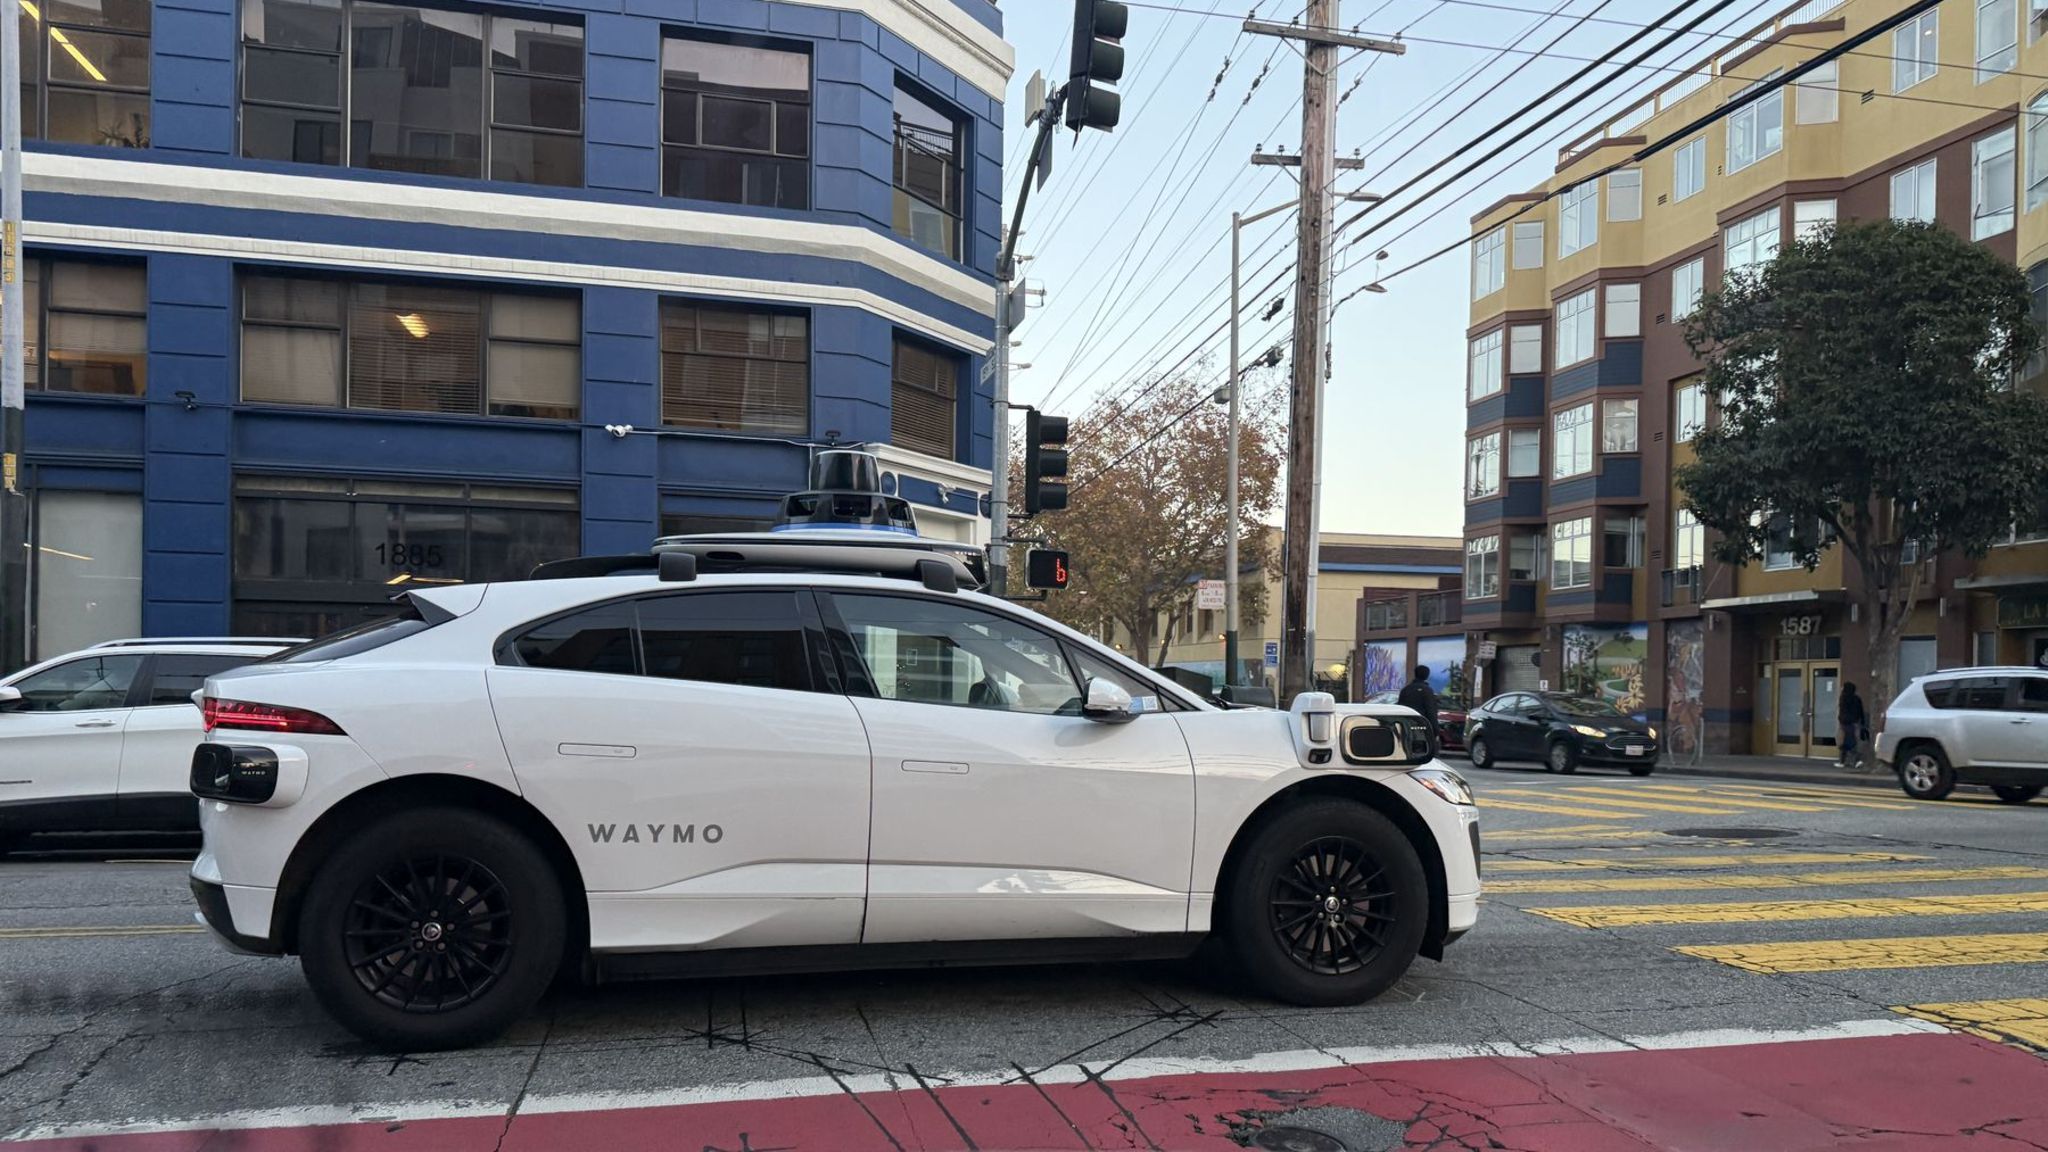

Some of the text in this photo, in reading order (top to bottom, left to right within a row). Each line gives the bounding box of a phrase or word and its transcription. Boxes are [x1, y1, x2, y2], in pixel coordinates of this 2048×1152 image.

[375, 542, 443, 567] 1885
[1780, 616, 1822, 635] 1587
[587, 823, 724, 844] WAYMO
